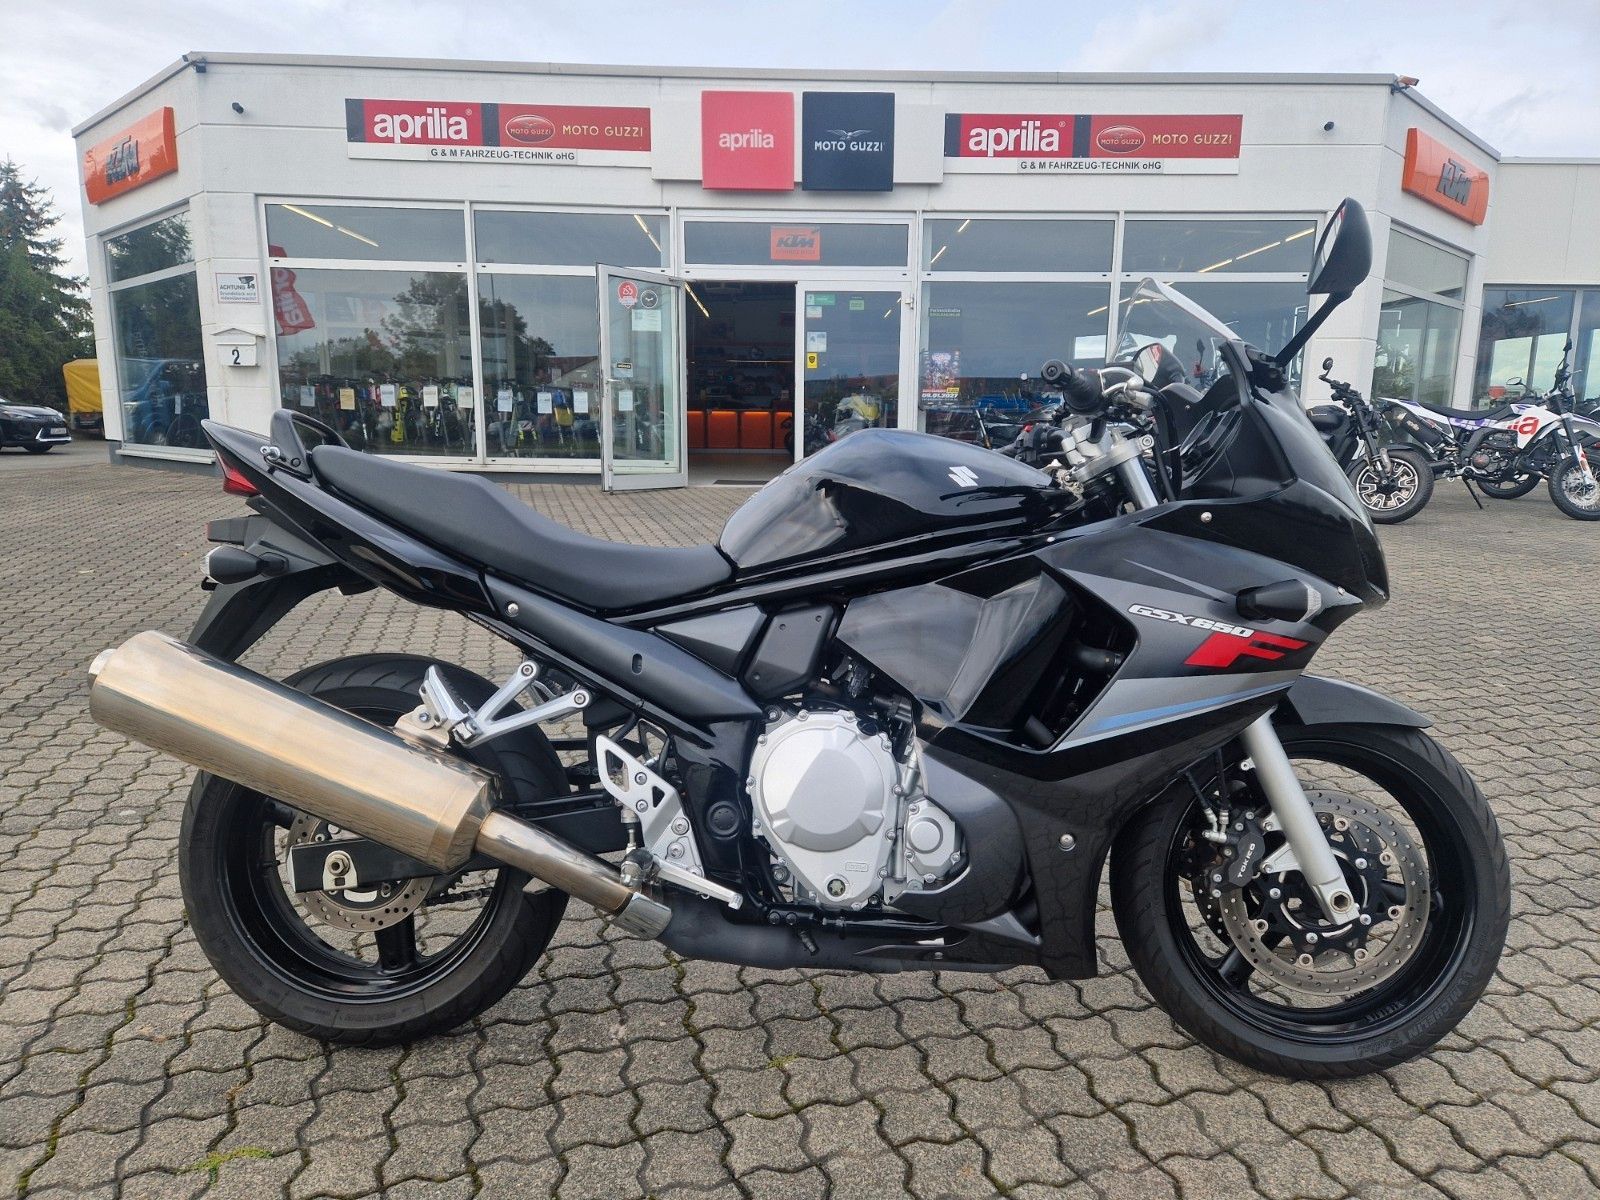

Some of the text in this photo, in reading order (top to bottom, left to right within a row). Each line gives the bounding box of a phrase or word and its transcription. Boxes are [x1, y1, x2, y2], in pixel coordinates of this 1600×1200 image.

[373, 107, 468, 144] aprilia
[562, 125, 643, 137] MOTO GUZZI
[719, 129, 774, 151] aprilia
[968, 120, 1060, 157] aprilia
[1152, 134, 1232, 145] MOTO GUZZI
[814, 140, 883, 152] MOTO GUZZI
[430, 148, 575, 161] G & M FAHRZEUG-TECHNIK oHG
[1020, 161, 1162, 170] G & M FAHRZEUG-TECHNIK oHG
[775, 234, 815, 248] KTM
[231, 348, 241, 365] 2
[1237, 842, 1256, 879] TOKICO
